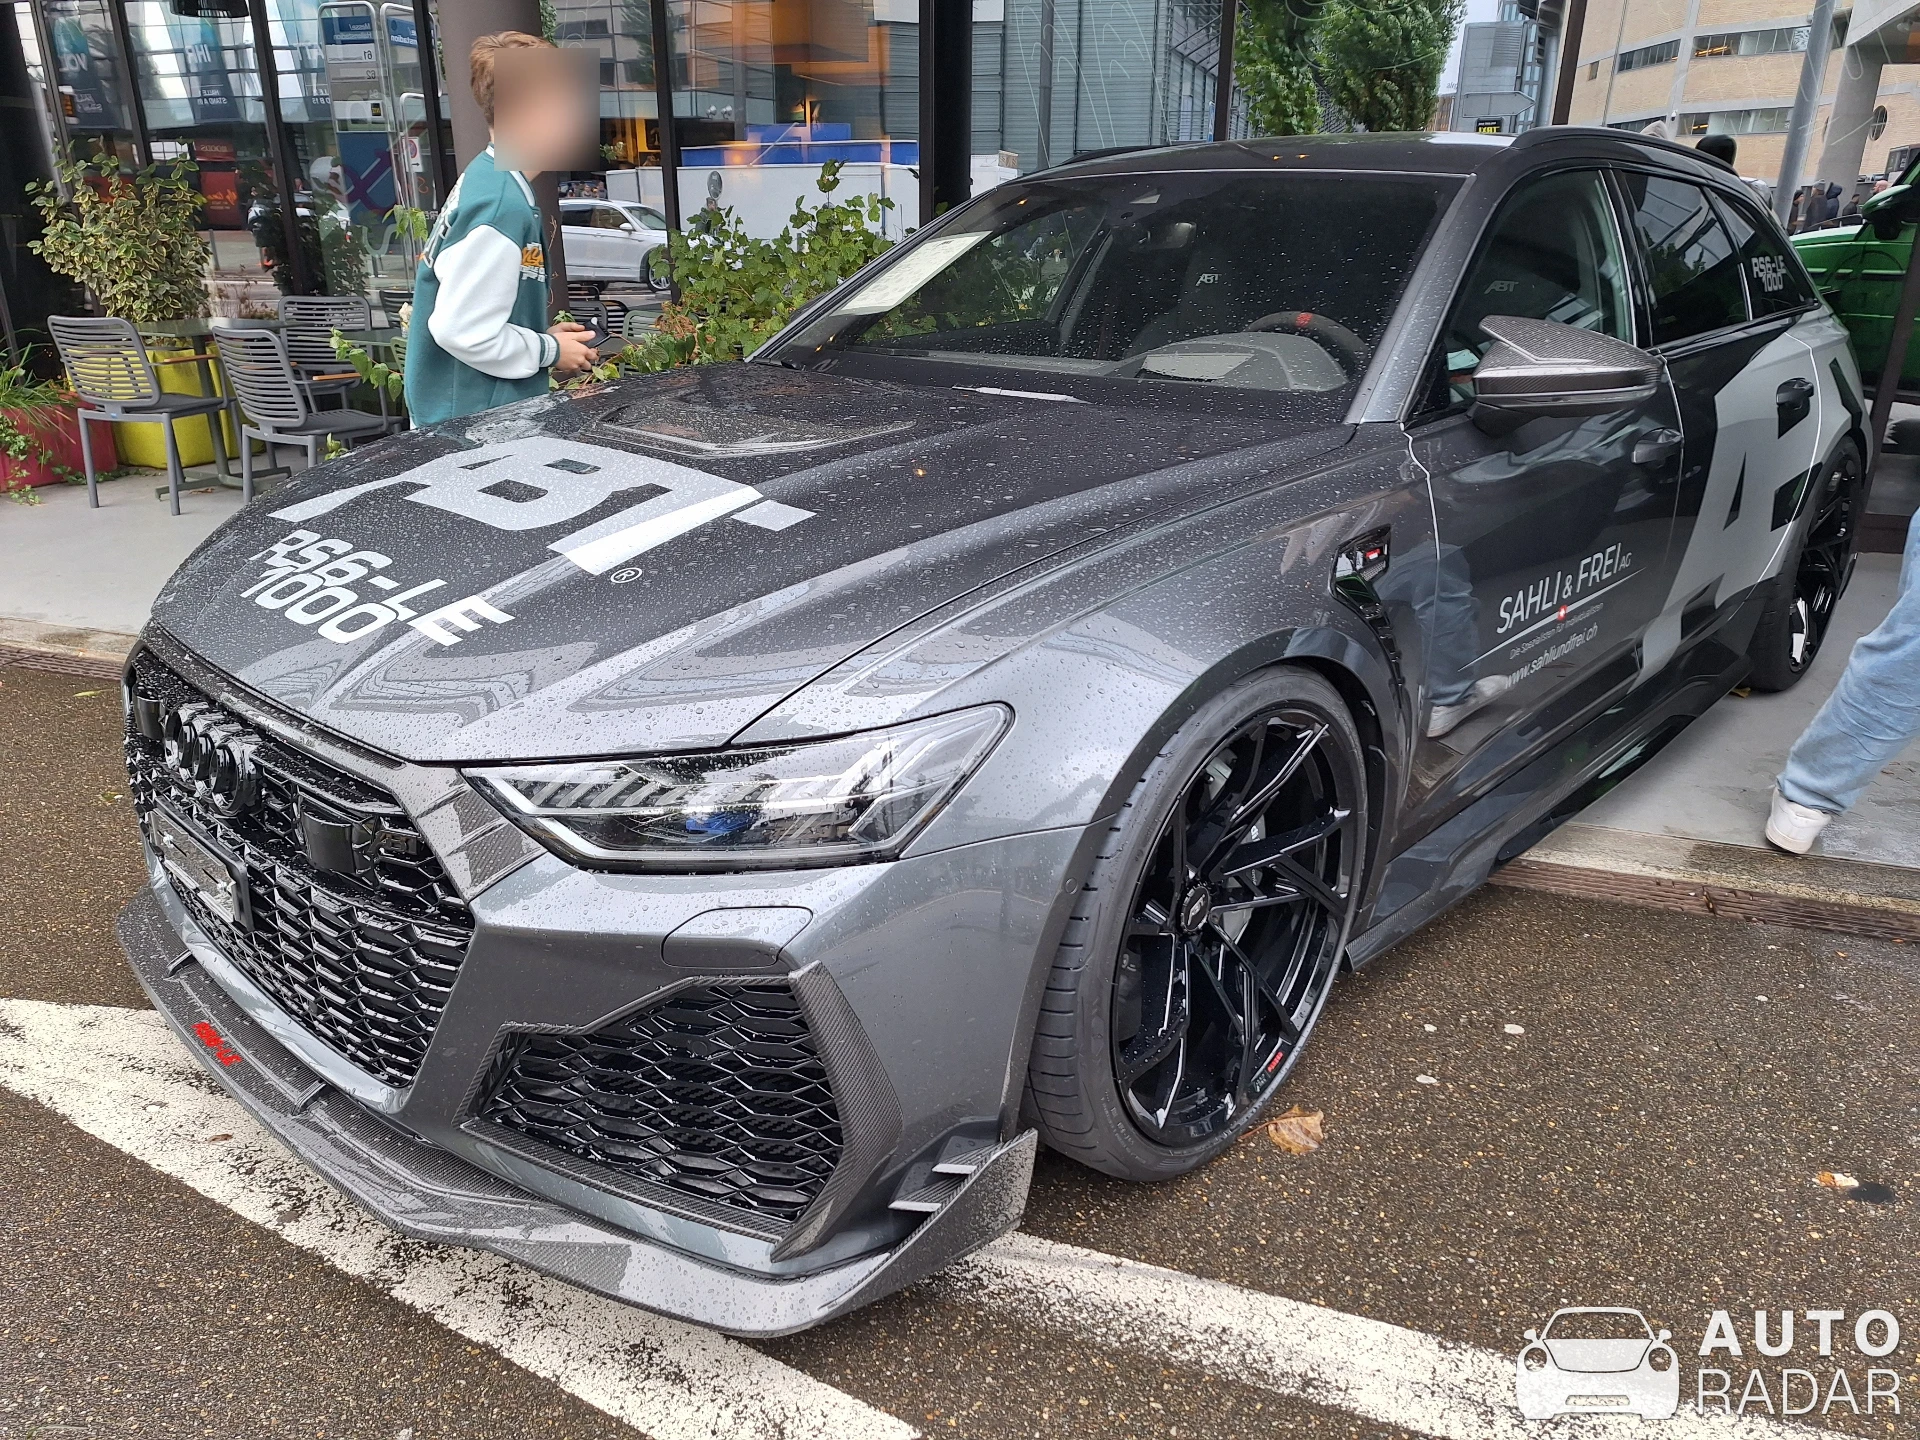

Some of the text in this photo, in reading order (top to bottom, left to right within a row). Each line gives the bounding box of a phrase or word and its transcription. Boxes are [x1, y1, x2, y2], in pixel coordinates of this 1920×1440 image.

[1195, 273, 1222, 286] ABT
[1484, 280, 1519, 294] ABT
[1762, 272, 1784, 292] 1000
[266, 436, 816, 576] ABT
[239, 566, 399, 644] 1000
[249, 529, 516, 647] RS6-LE
[1497, 542, 1633, 634] SAHLI & FREI AG
[1504, 622, 1599, 690] www.sahliundfrei.ch
